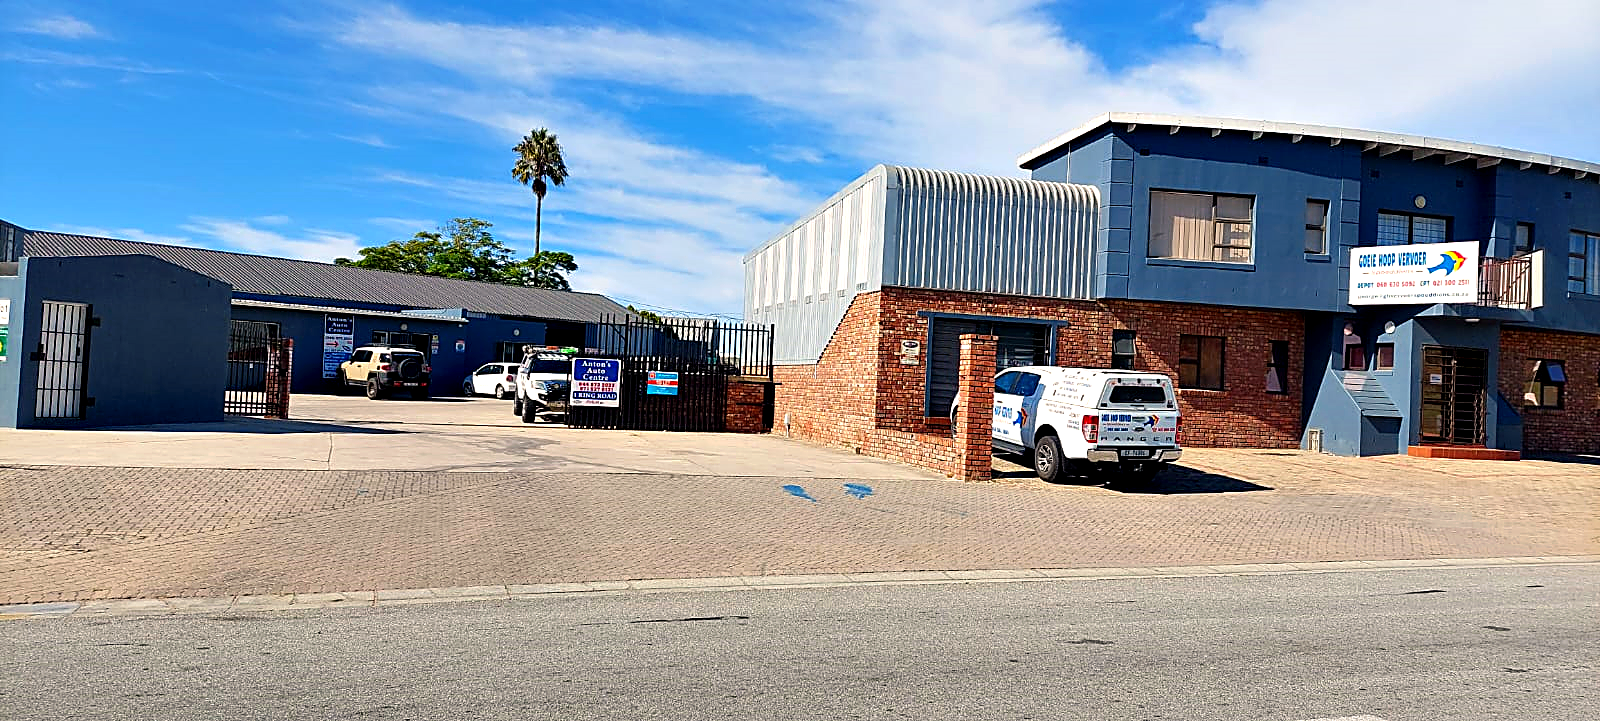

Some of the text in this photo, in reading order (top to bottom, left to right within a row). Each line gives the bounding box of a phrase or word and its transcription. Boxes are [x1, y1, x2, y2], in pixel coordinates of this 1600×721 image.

[1359, 252, 1426, 268] GOEIE HOOP VERVOER
